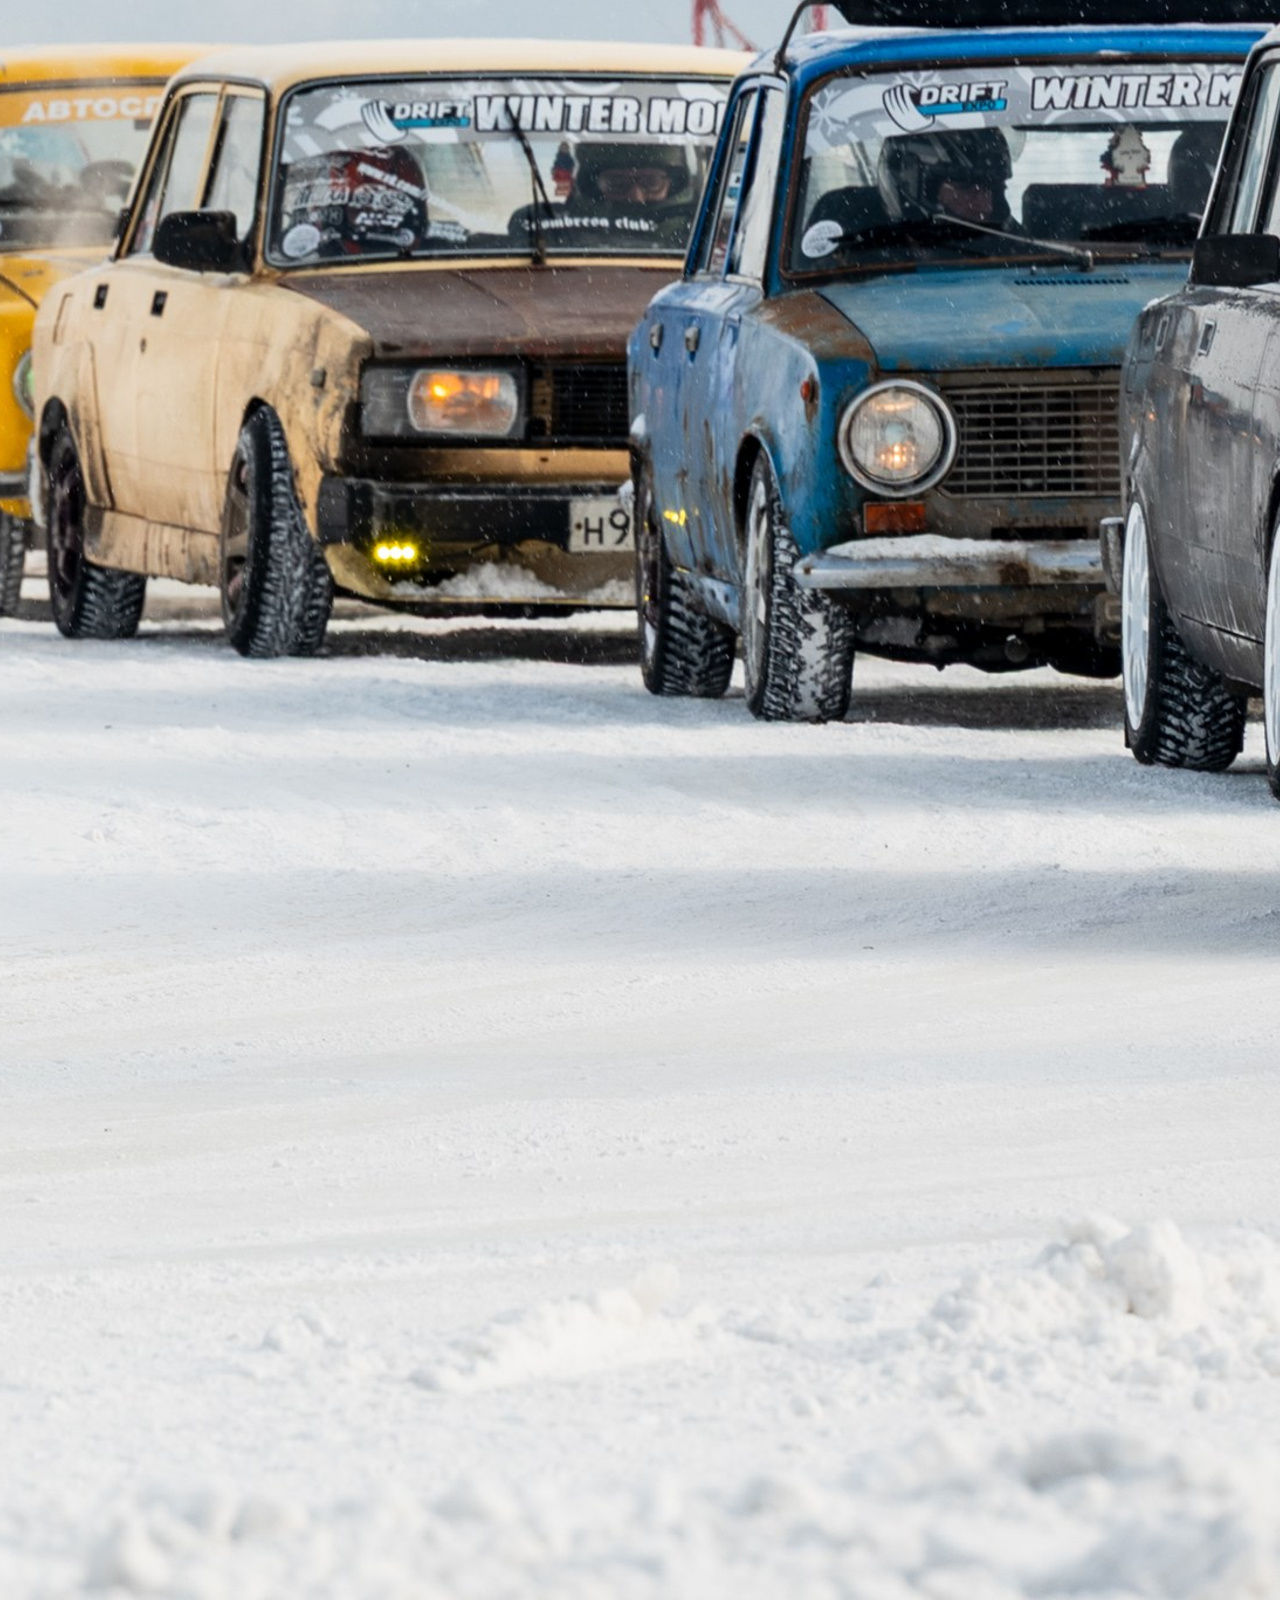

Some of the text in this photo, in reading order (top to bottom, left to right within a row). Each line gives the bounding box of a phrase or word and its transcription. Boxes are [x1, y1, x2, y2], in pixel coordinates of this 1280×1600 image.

[919, 81, 1008, 106] DRIFT
[1031, 73, 1202, 110] WINTER
[393, 101, 470, 119] DRIFT
[473, 95, 642, 133] WINTER
[962, 99, 997, 112] EXPO
